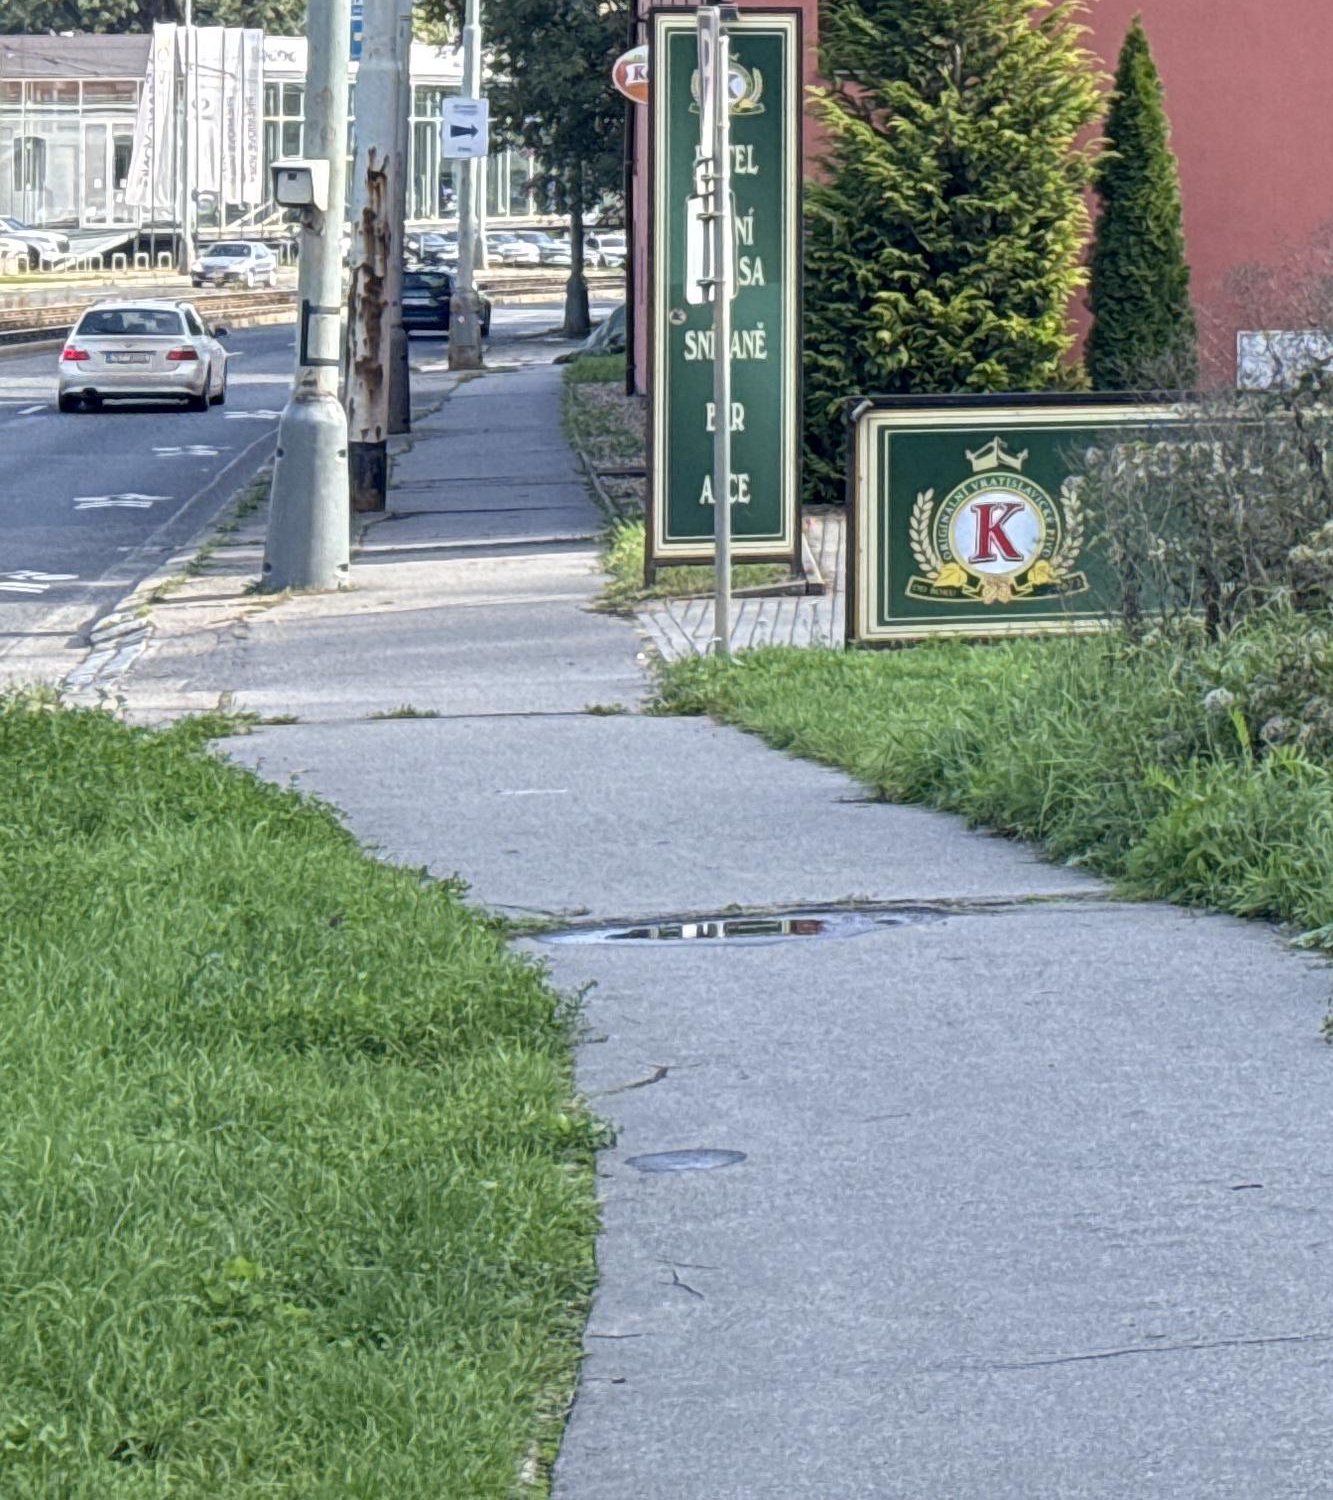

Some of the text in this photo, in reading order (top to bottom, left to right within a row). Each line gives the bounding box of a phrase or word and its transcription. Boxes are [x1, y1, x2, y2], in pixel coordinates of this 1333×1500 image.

[684, 321, 768, 361] SNÍANĚ
[705, 402, 746, 432] BR
[699, 473, 751, 505] ACE
[969, 502, 1025, 564] K
